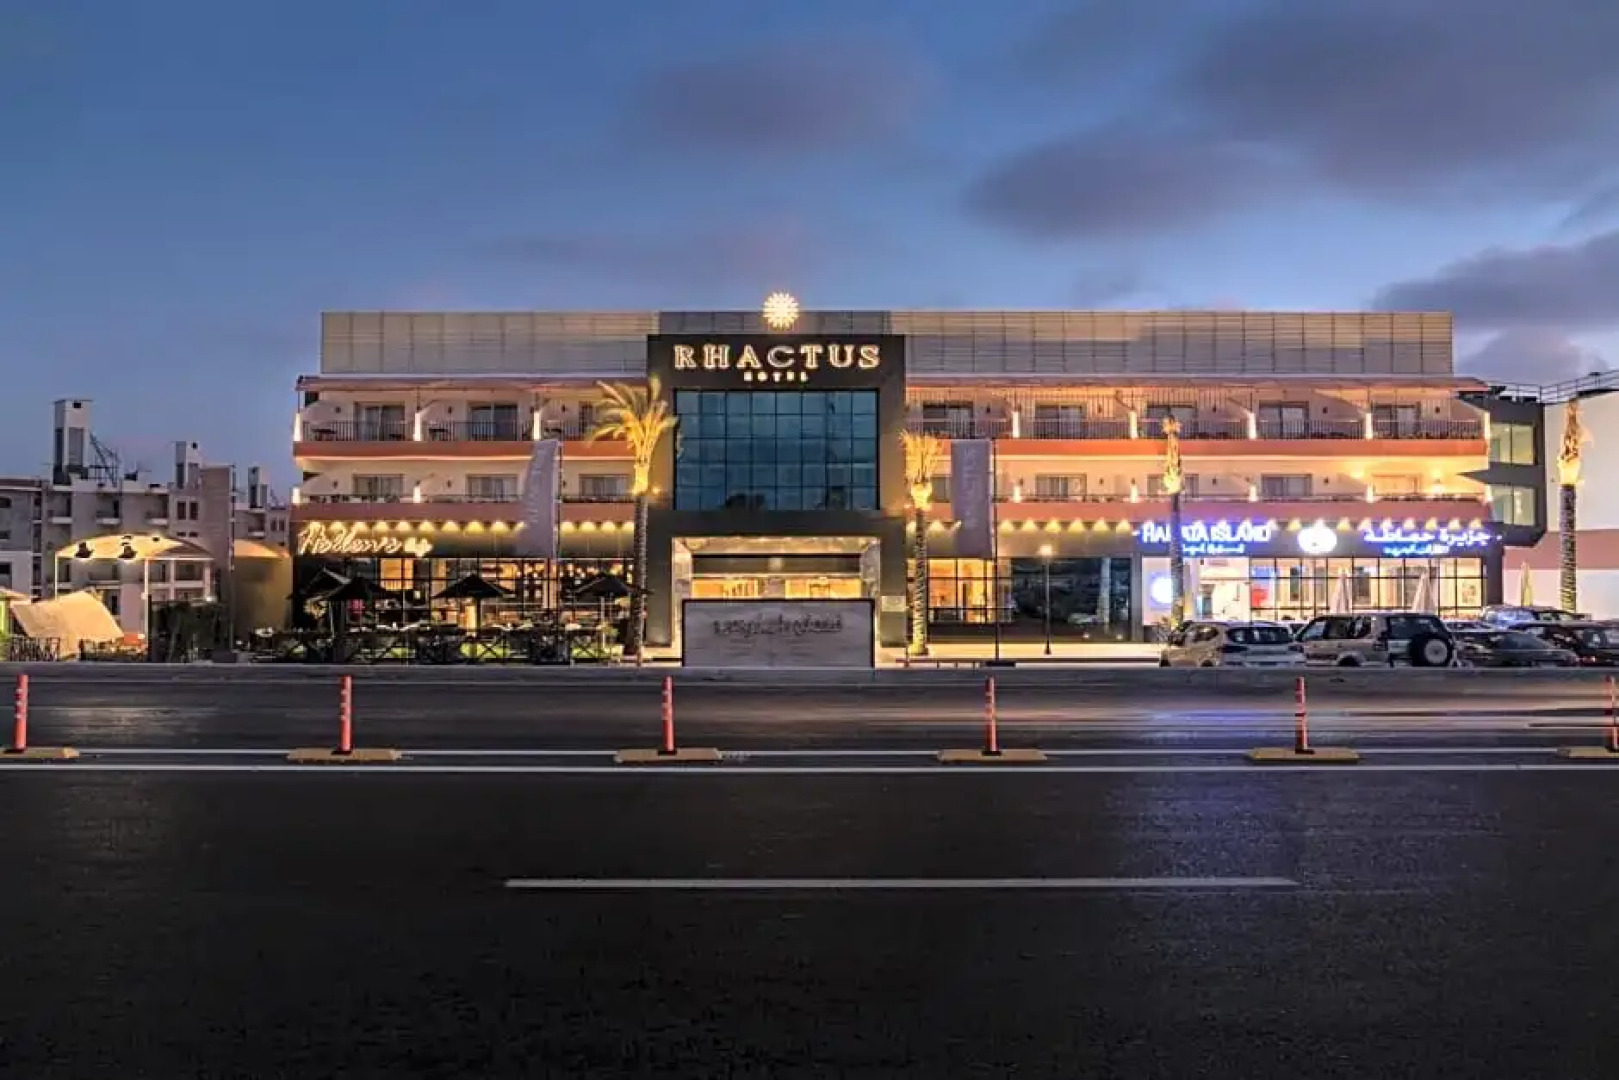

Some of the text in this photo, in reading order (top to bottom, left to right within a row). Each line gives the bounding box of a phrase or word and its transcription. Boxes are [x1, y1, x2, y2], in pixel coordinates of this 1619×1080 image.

[673, 344, 881, 370] RHACTUS
[743, 371, 809, 382] HOTEL
[1210, 520, 1272, 542] ISLAND
